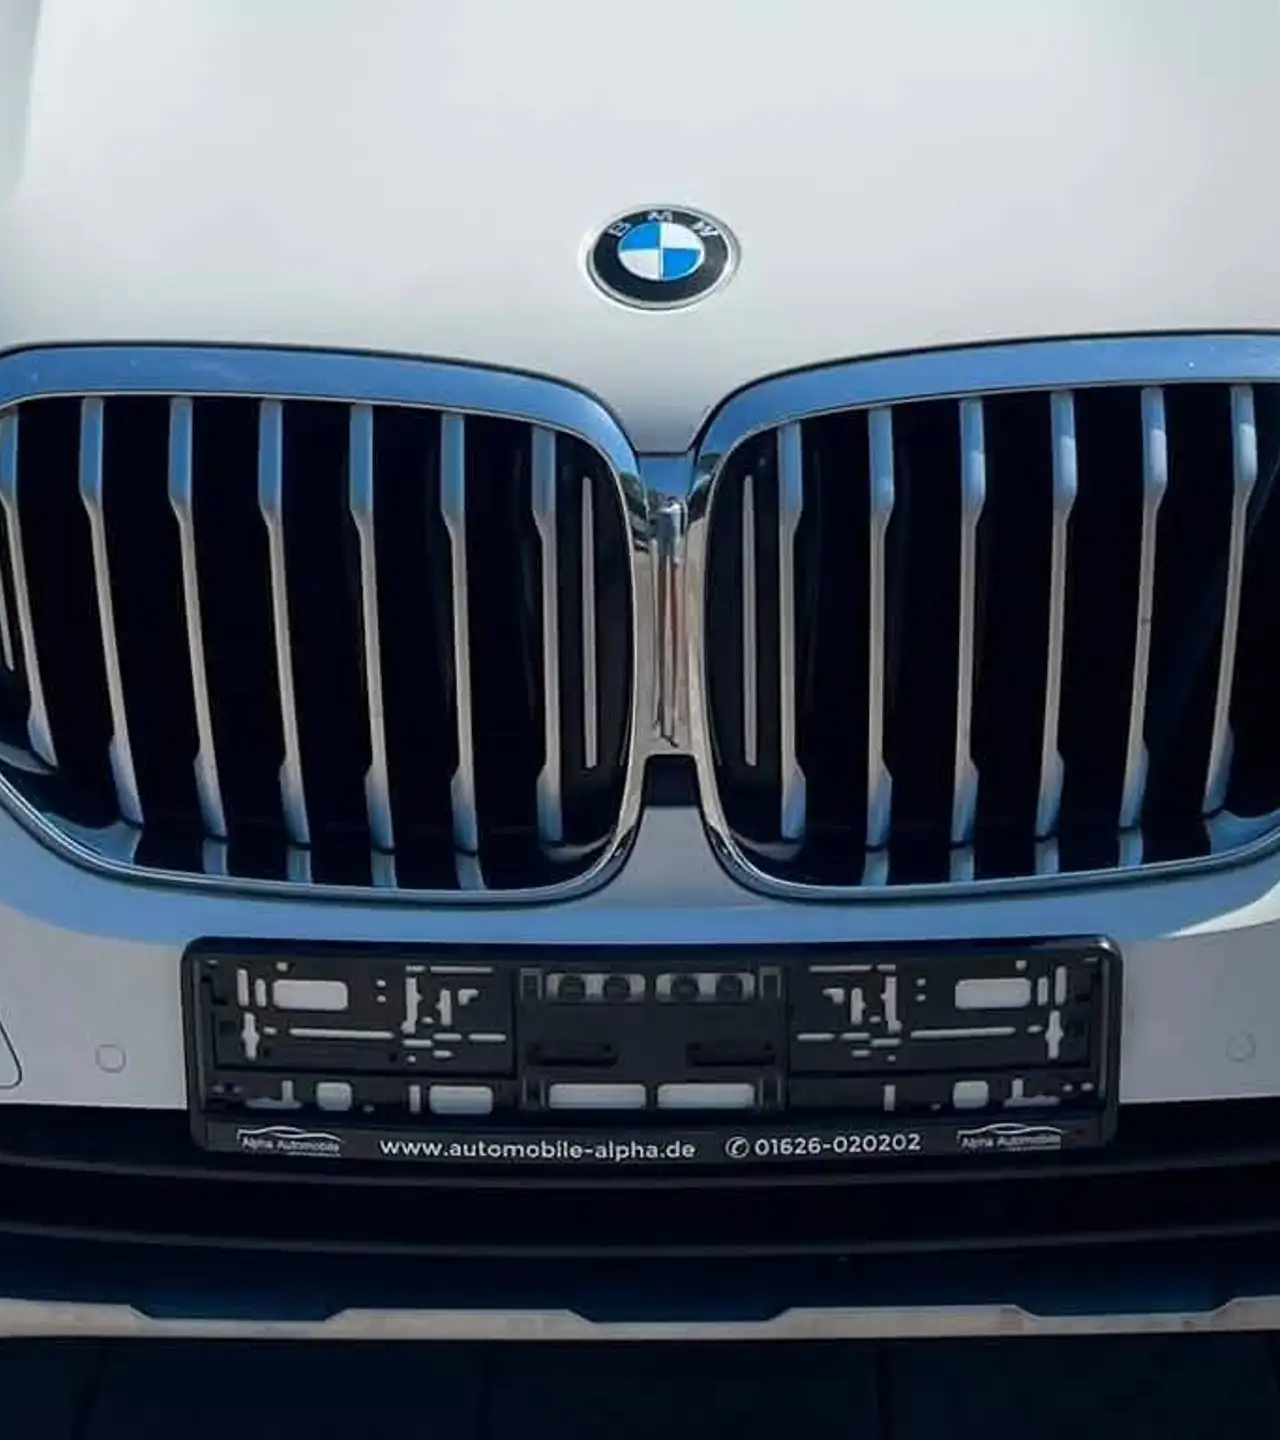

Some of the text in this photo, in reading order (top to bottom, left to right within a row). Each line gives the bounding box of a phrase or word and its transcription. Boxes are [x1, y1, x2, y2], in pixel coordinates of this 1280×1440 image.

[607, 210, 718, 237] BMW
[379, 1139, 696, 1162] www.automobile-alpha.de
[754, 1133, 921, 1156] 01626-020202
